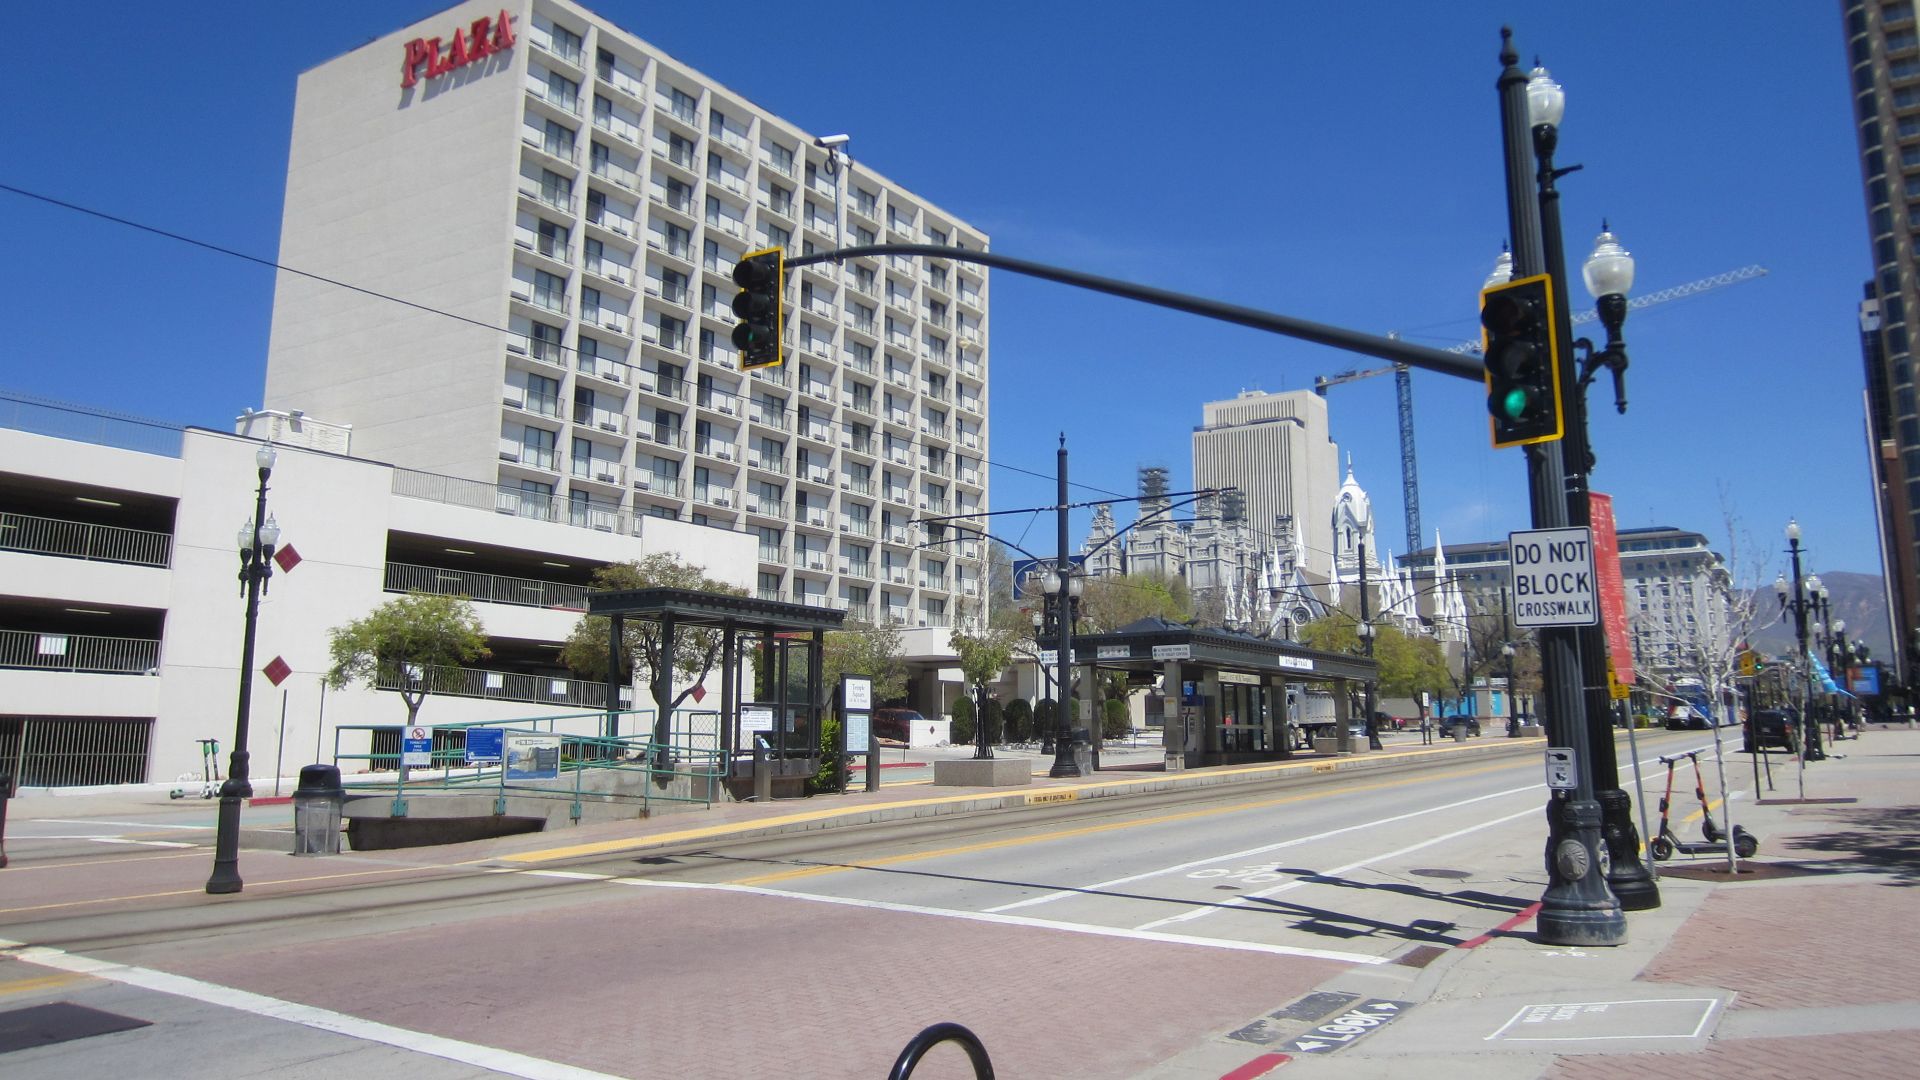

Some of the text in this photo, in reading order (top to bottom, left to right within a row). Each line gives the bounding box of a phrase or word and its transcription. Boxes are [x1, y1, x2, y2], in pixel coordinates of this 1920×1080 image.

[400, 9, 516, 88] PLAZA
[1515, 541, 1587, 565] DO NOT
[1516, 572, 1590, 596] BLOCK
[1517, 600, 1592, 617] CROSSWALK
[1301, 1009, 1395, 1042] LOOK
